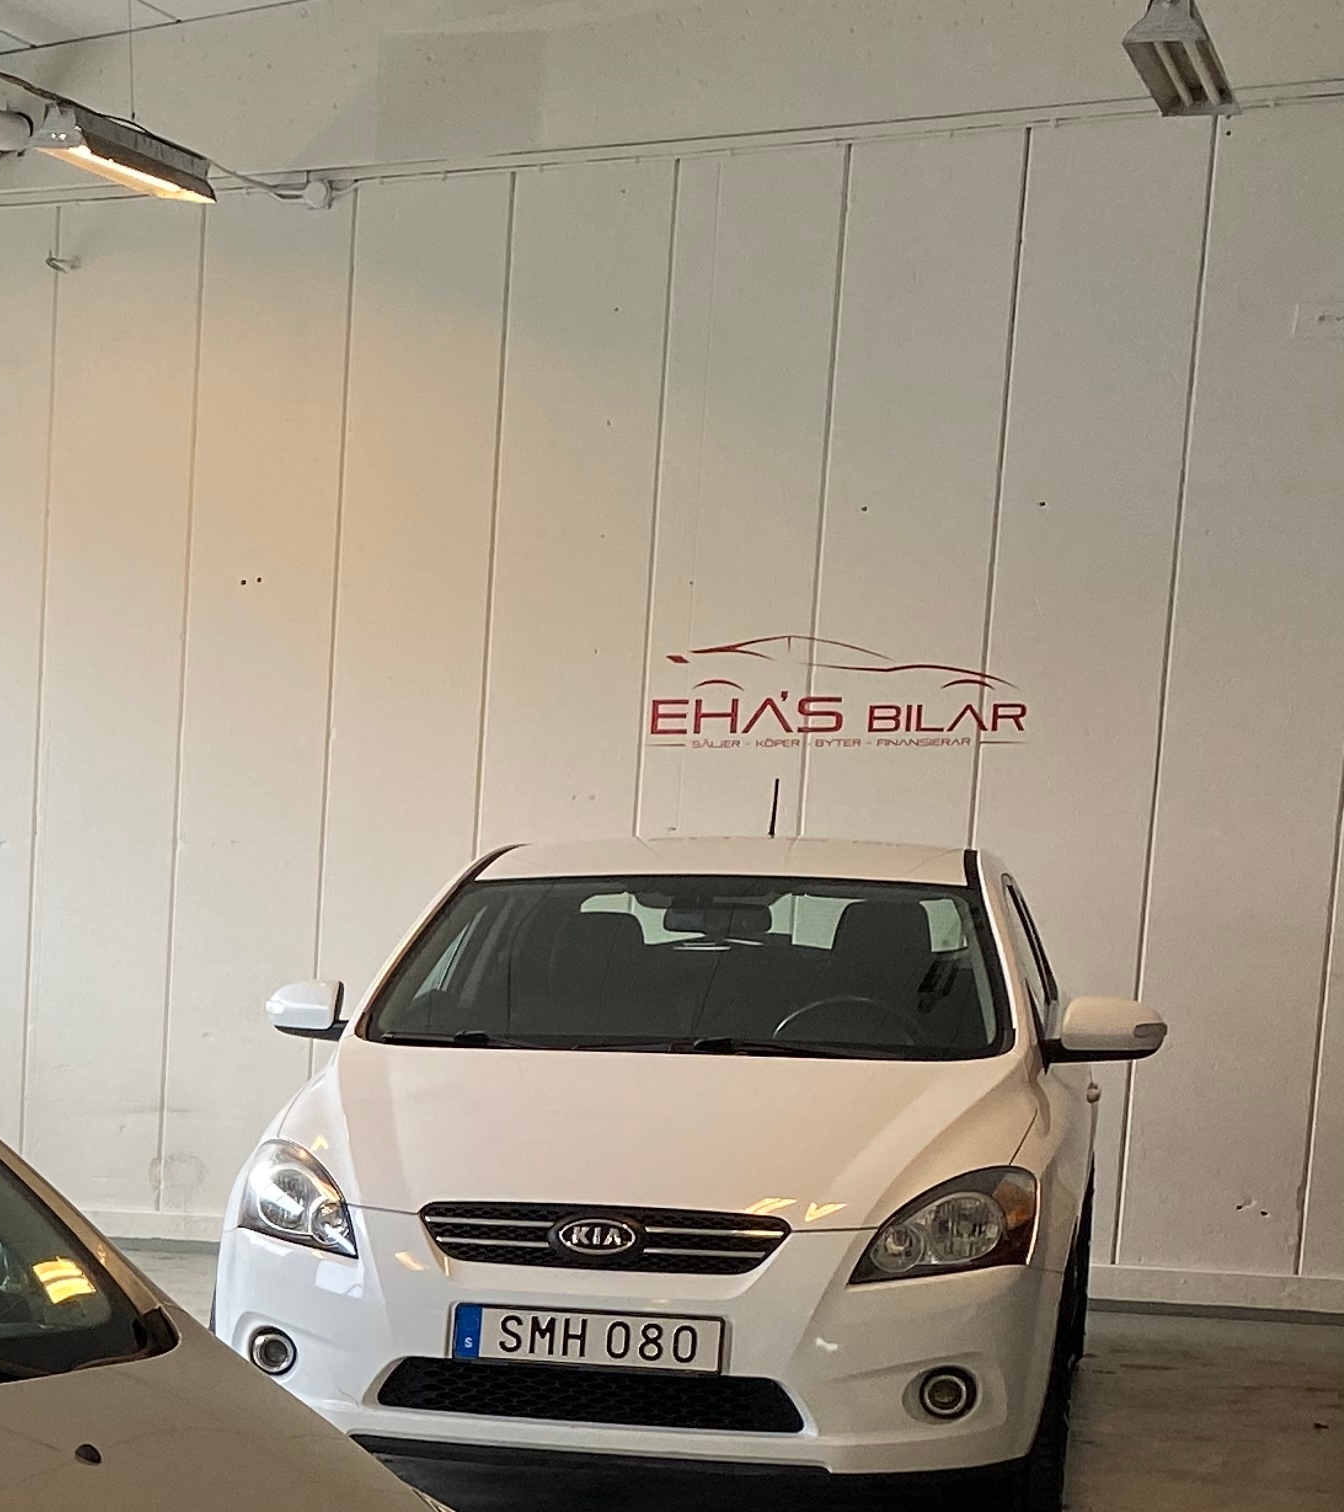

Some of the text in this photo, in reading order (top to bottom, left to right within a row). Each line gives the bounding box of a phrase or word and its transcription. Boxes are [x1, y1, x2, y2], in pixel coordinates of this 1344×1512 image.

[649, 690, 1028, 736] EHA'S BILAR
[755, 737, 800, 748] KÖPER
[814, 738, 862, 748] BYTER
[876, 737, 971, 748] FINANSIERAR
[571, 1225, 623, 1246] KIA
[464, 1336, 473, 1349] S
[498, 1314, 699, 1364] SMH 080
